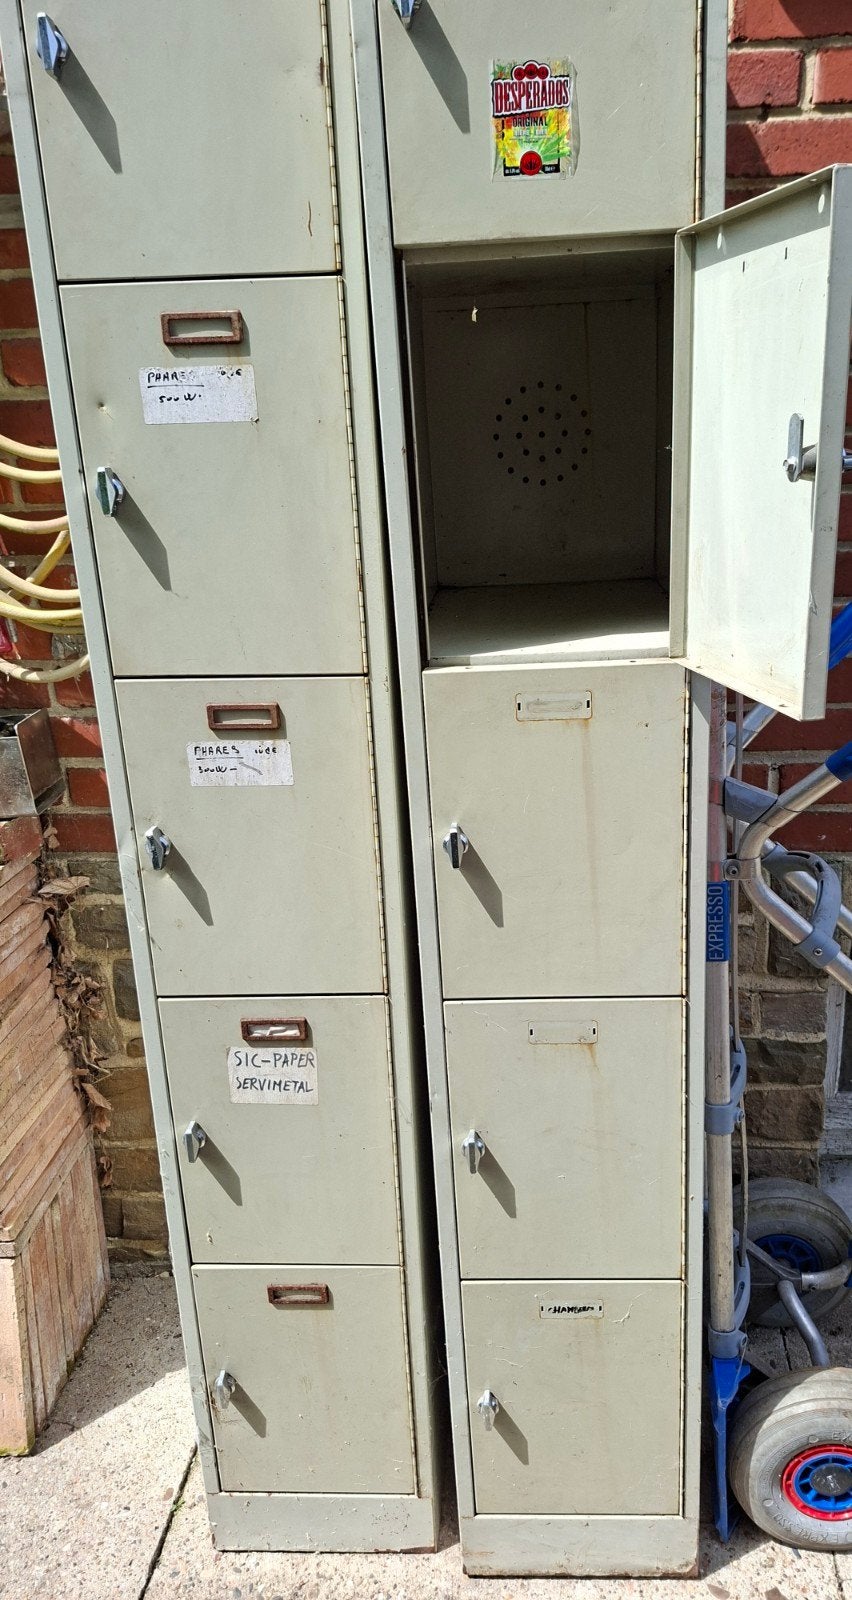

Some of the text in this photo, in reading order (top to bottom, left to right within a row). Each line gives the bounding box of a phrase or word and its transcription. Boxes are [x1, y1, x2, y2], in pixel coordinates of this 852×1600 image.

[494, 80, 569, 113] DESPERADOS
[512, 116, 548, 127] ORIGINAL
[194, 745, 240, 756] PHARES
[707, 882, 725, 960] EXPRESSO
[234, 1050, 315, 1069] SIC-PAPER
[236, 1076, 313, 1094] SERVIMETAL
